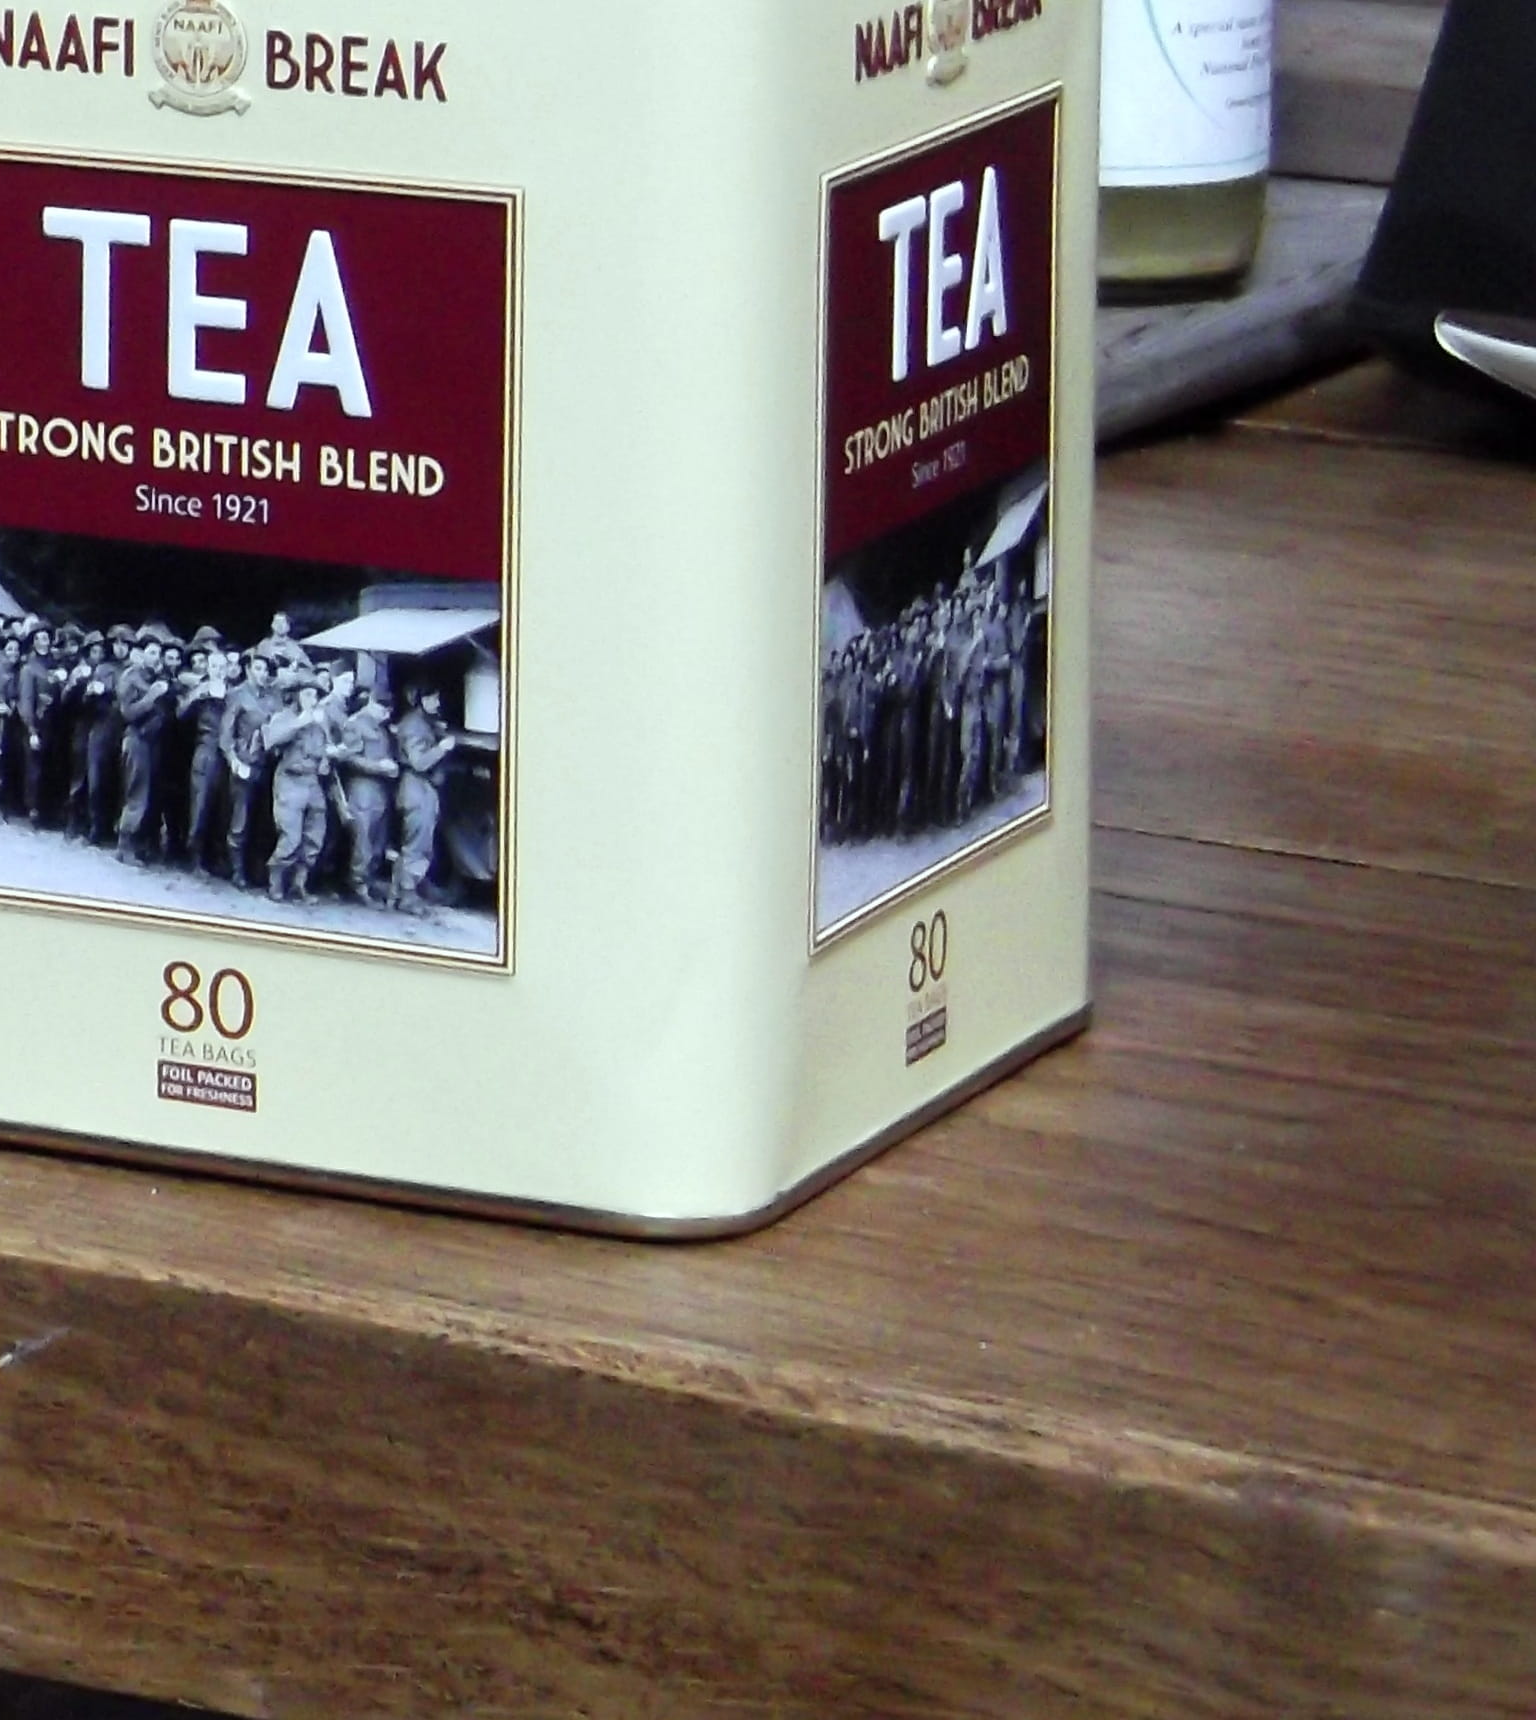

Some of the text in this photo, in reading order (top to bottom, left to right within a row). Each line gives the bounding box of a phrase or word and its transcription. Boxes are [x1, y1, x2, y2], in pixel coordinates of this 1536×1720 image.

[173, 18, 223, 35] NAAFI
[855, 0, 924, 82] NAAFI
[265, 28, 449, 103] BREAK
[878, 165, 1008, 383] TEA
[42, 205, 373, 419] TEA
[844, 353, 1029, 475] STRONG BRITISH BLEND
[151, 426, 302, 483] BRITISH
[319, 445, 445, 497] BLEND
[134, 484, 270, 525] Since 1921
[909, 909, 947, 993] 80
[160, 960, 254, 1040] 80
[159, 1036, 257, 1068] TEA BAGS
[161, 1064, 252, 1092] FOIL PACKED
[161, 1083, 184, 1097] FOR
